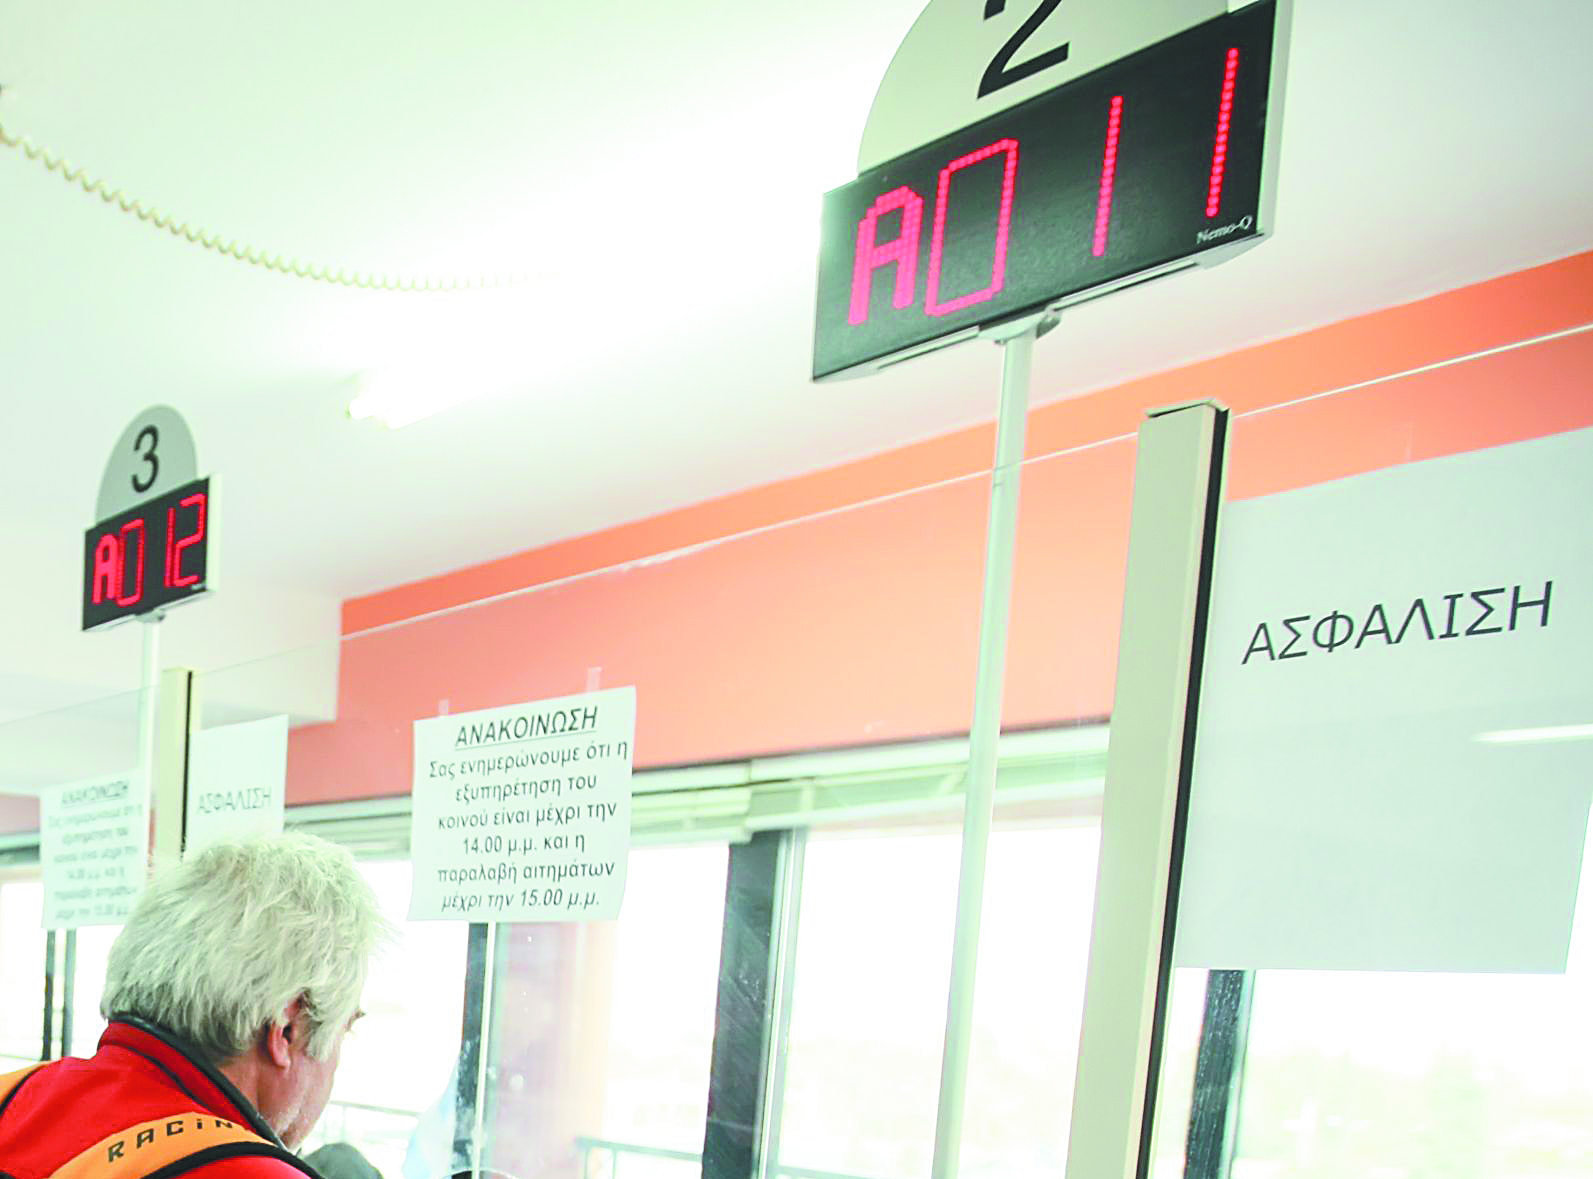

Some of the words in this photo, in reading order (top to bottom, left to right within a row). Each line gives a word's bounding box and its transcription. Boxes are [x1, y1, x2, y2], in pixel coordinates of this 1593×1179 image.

[131, 424, 159, 493] 3
[1241, 580, 1553, 665] ΑΣΦΑΛΙΣΗ
[455, 705, 598, 746] ΑΝΑΚΟΙΝΩΣΗ
[429, 761, 455, 780] Σας
[460, 747, 579, 775] ενημερώνουμε
[586, 740, 610, 759] ότι
[617, 741, 627, 761] η
[456, 777, 560, 804] εξυπηρέτηση
[568, 774, 597, 789] του
[439, 809, 488, 829] κοινού
[493, 807, 529, 825] είναι
[536, 803, 580, 827] μέχρι
[587, 802, 617, 821] την
[463, 836, 502, 854] 14.00
[508, 836, 537, 856] μ.μ.
[544, 834, 568, 849] και
[575, 833, 584, 852] η
[438, 862, 517, 885] παραλαβή
[523, 859, 615, 883] αιτημάτων
[442, 892, 482, 912] μέχρι
[488, 893, 513, 908] την
[521, 888, 563, 906] 15.00
[567, 890, 599, 910] μ.μ.
